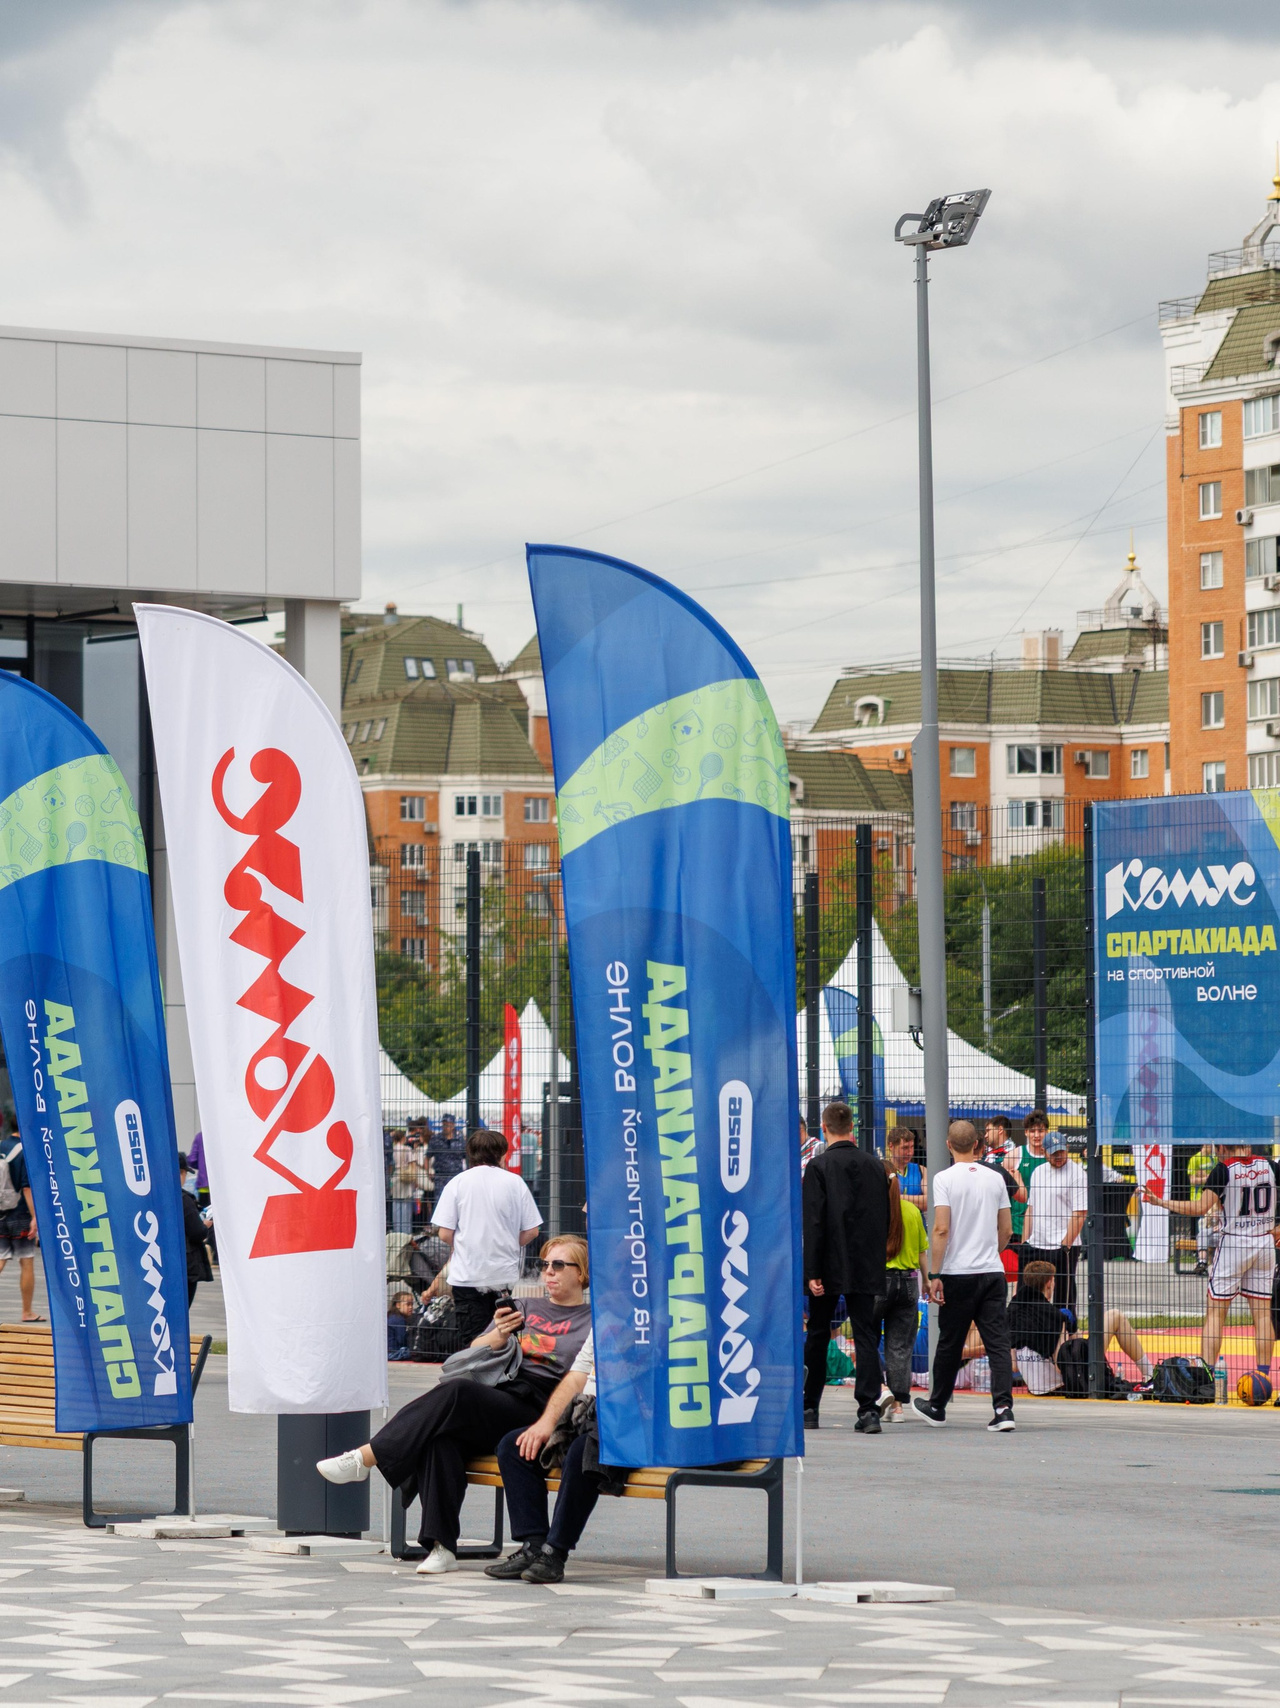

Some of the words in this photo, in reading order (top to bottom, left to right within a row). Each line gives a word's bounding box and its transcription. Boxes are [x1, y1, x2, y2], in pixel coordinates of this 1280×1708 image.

[1106, 858, 1257, 921] Комус
[1106, 924, 1277, 958] СПАРТАКИАДА
[1107, 969, 1125, 982] на
[1128, 961, 1216, 984] спортивной
[1238, 1182, 1272, 1217] 10
[525, 1313, 572, 1336] PEACH
